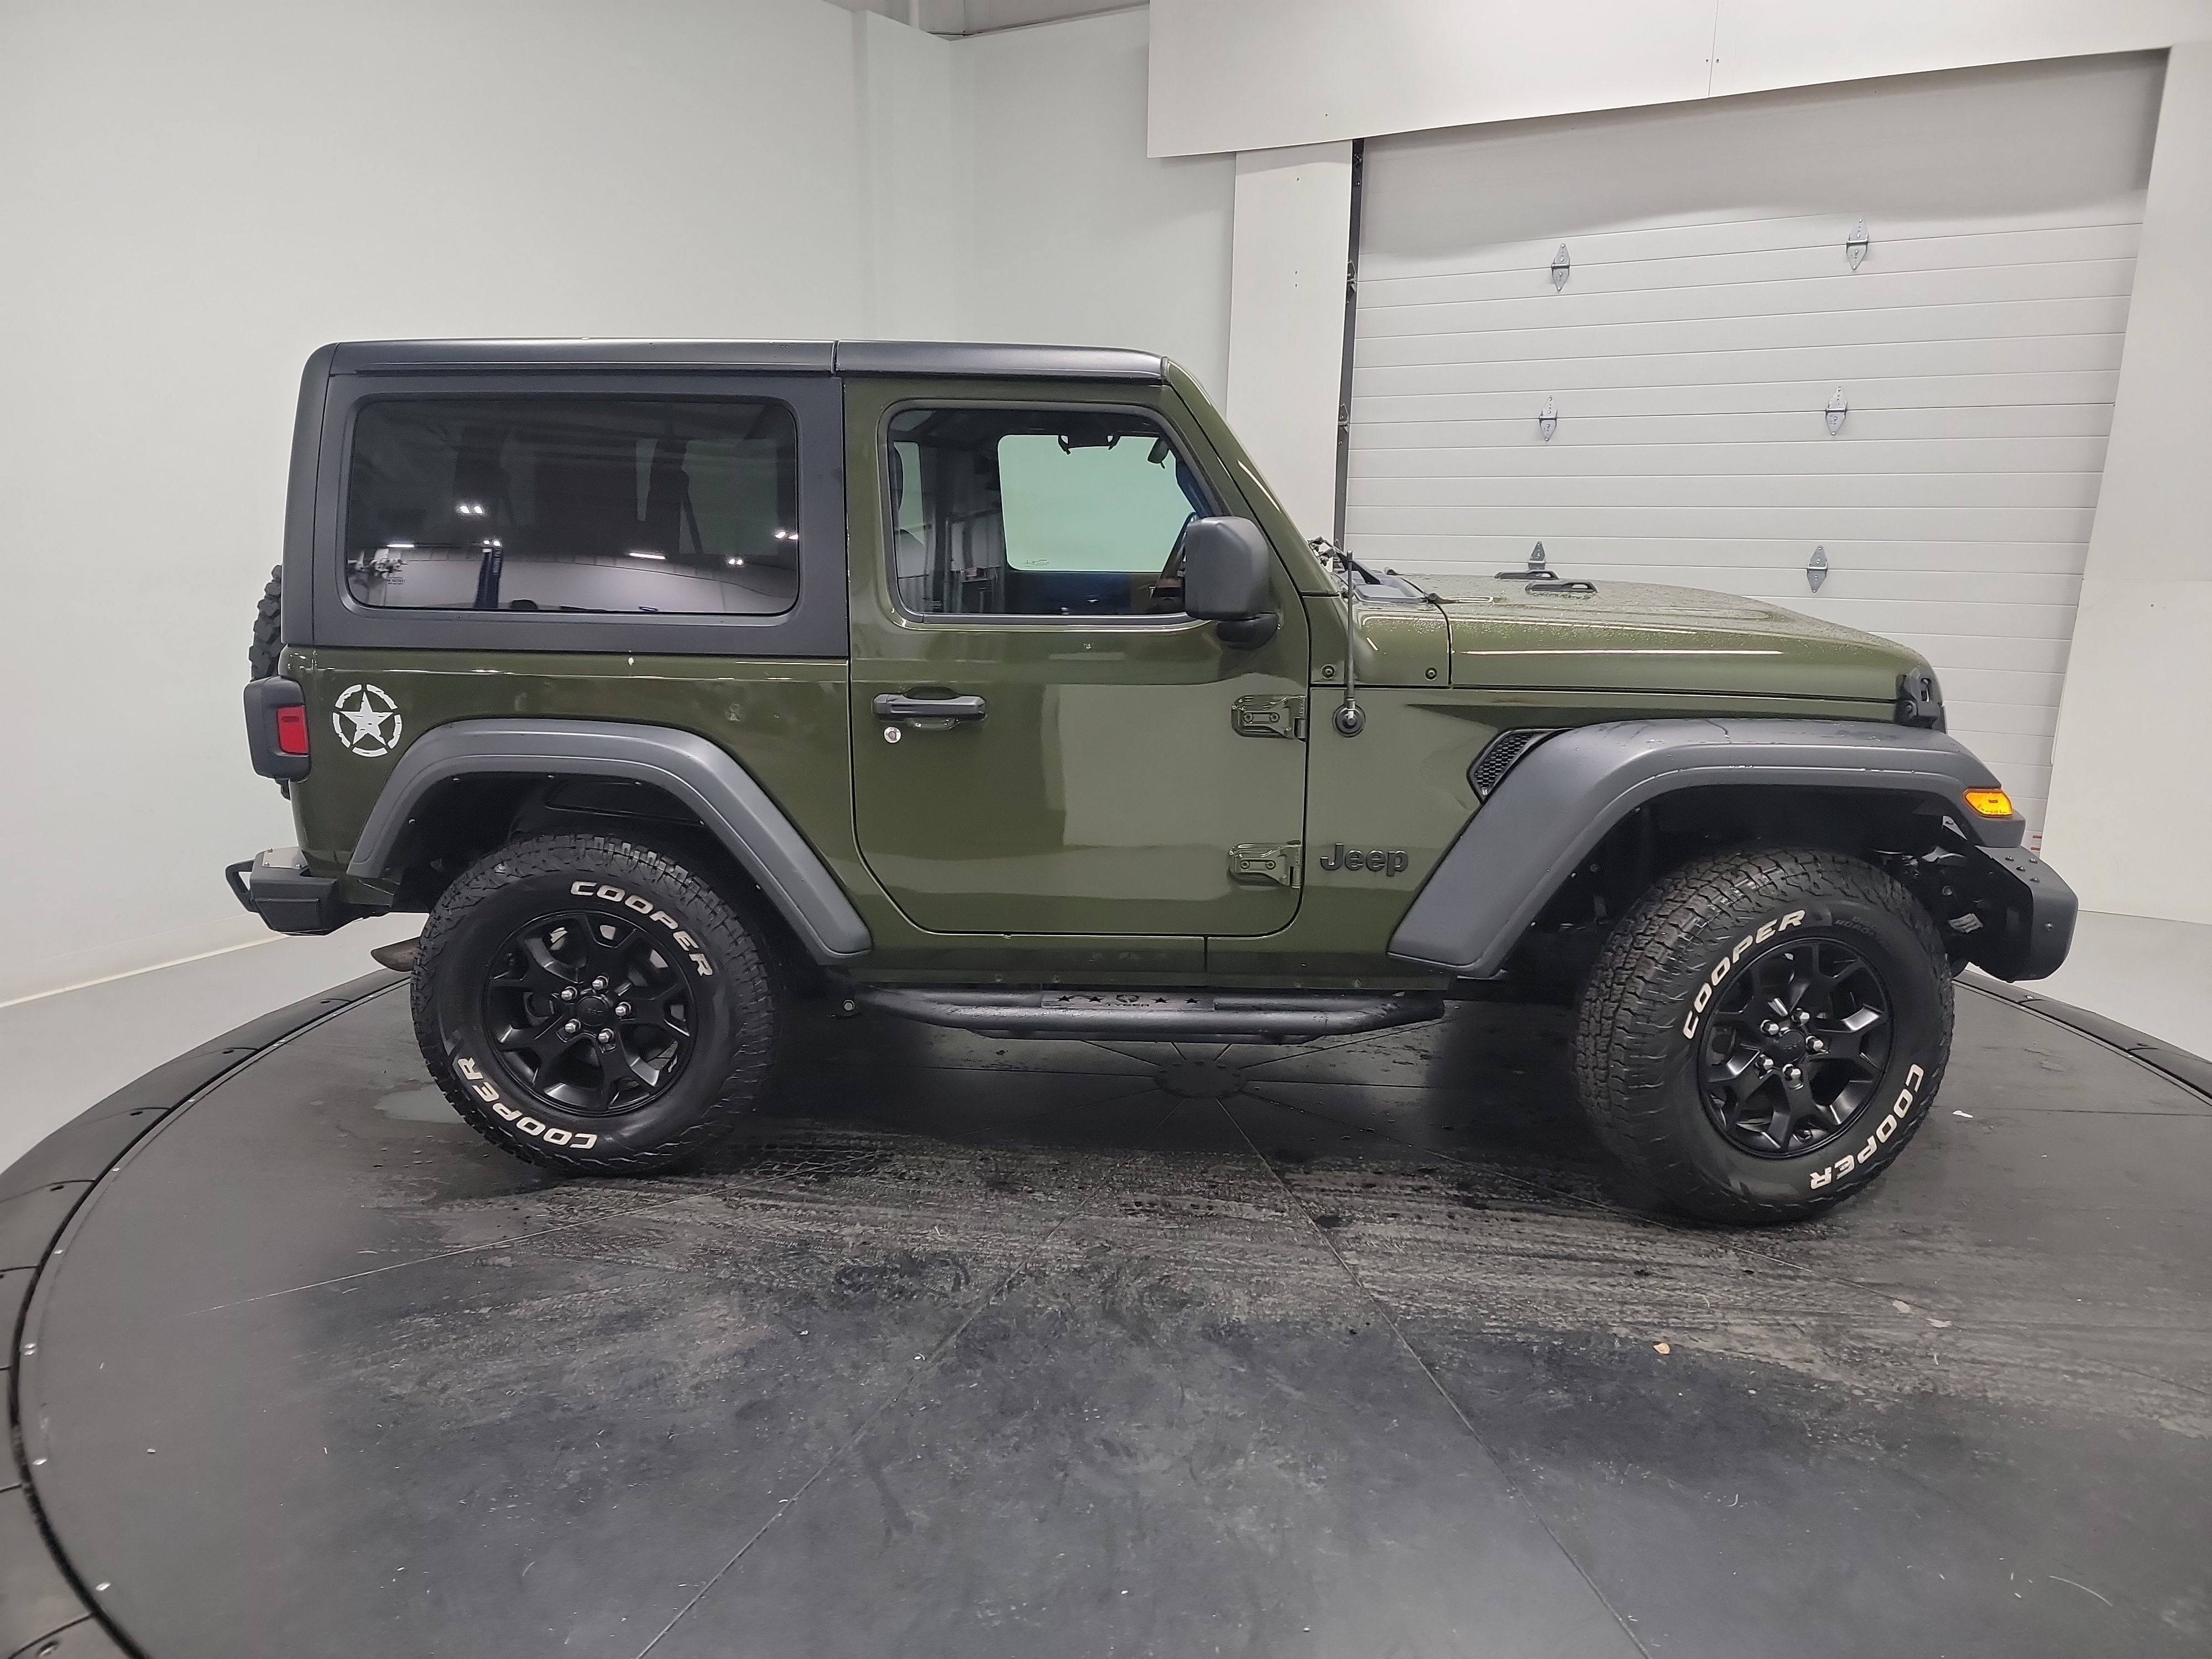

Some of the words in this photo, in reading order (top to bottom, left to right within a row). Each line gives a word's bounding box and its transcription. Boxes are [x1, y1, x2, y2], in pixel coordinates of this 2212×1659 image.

[1320, 842, 1408, 877] Jeep
[570, 881, 713, 977] COOPER
[1683, 910, 1806, 1039] COOPER
[457, 1057, 598, 1149] COOPER
[1809, 1064, 1924, 1190] COOPER
